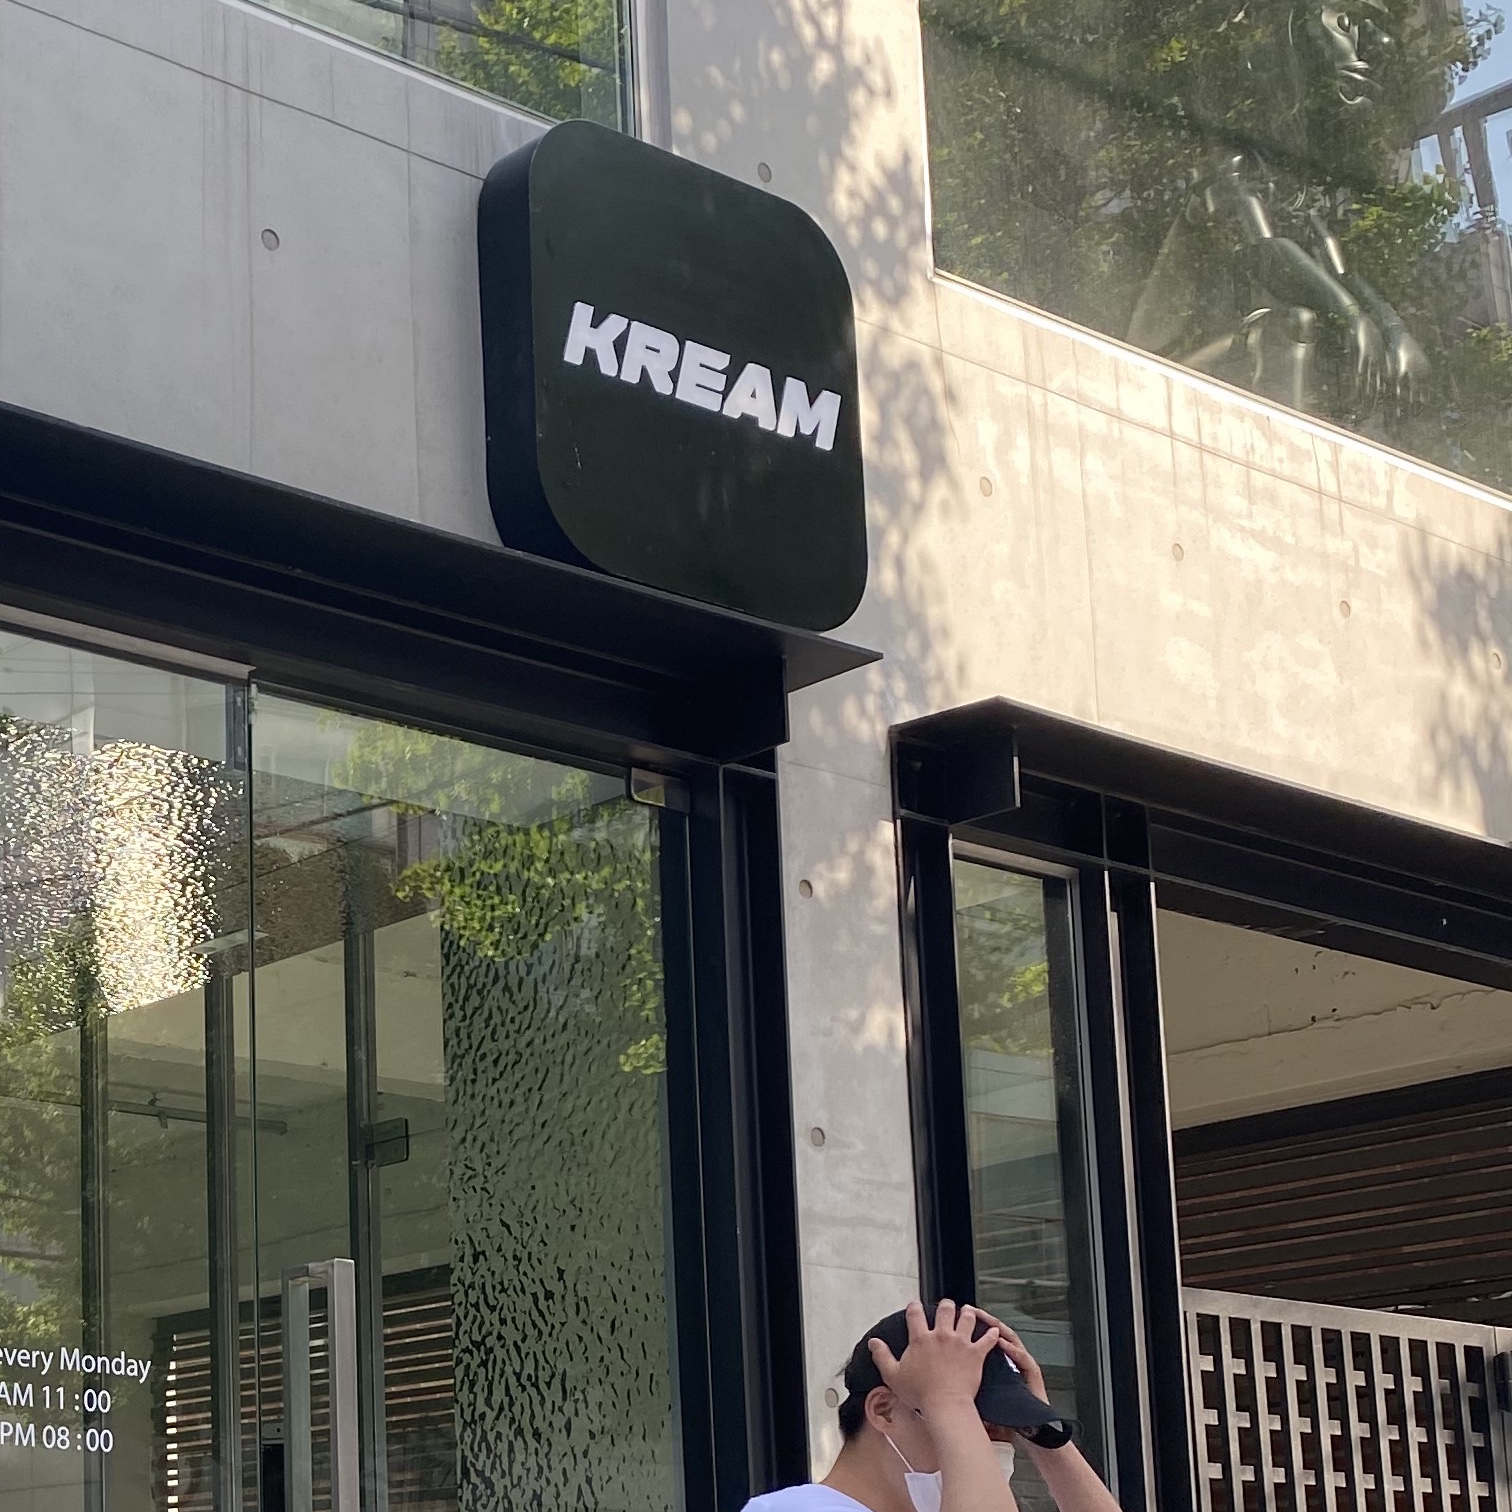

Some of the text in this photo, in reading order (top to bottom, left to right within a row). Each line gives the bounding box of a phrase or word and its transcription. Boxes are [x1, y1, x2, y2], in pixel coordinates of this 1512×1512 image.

[564, 300, 842, 451] KREAM
[60, 1347, 152, 1384] Monday
[0, 1421, 36, 1448] PM
